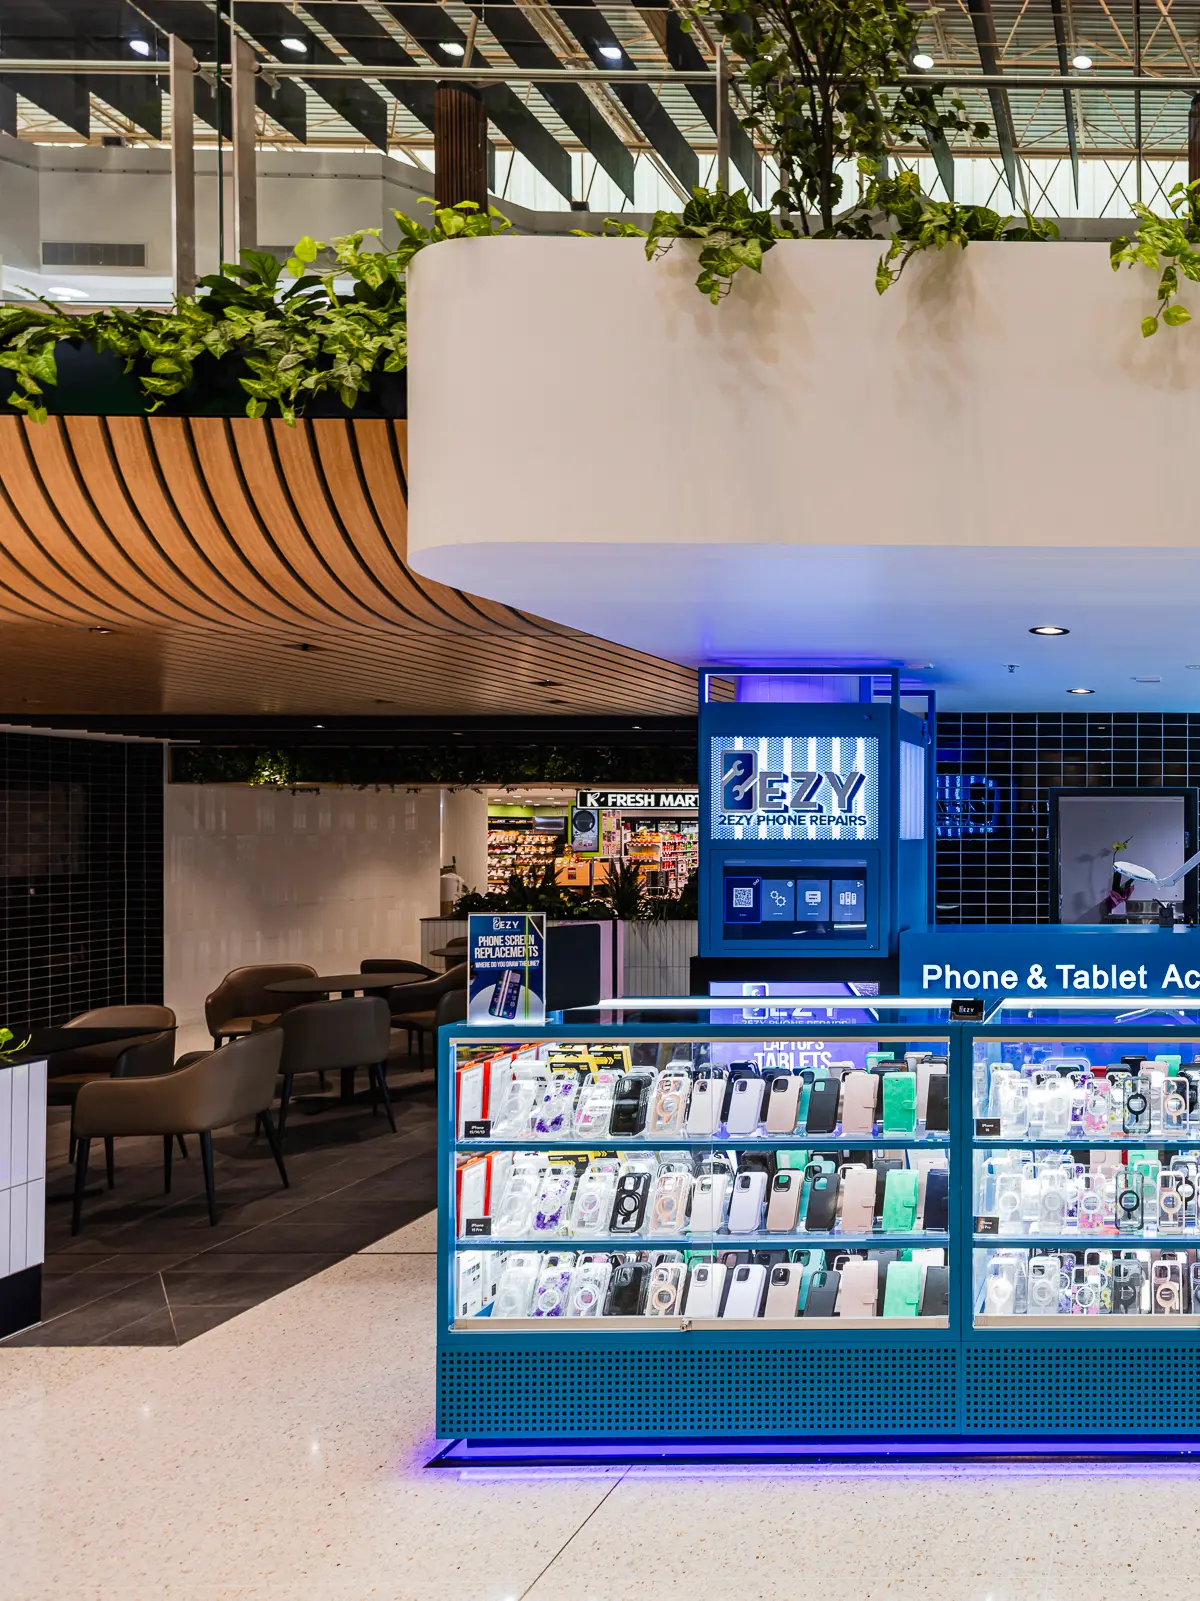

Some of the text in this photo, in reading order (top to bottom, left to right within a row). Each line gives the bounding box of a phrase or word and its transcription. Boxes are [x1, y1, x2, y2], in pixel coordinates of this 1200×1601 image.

[607, 793, 655, 807] FRESH
[718, 814, 867, 826] 2EZY PHONE REPAIRS
[479, 935, 534, 946] PHONE SCREEN
[475, 946, 538, 958] REPLACEMENTS
[922, 964, 1019, 990] Phone
[1026, 964, 1048, 990] &
[1055, 964, 1147, 990] Tablet
[763, 1041, 824, 1051] LAPTOPS
[754, 1052, 832, 1070] TABLETS
